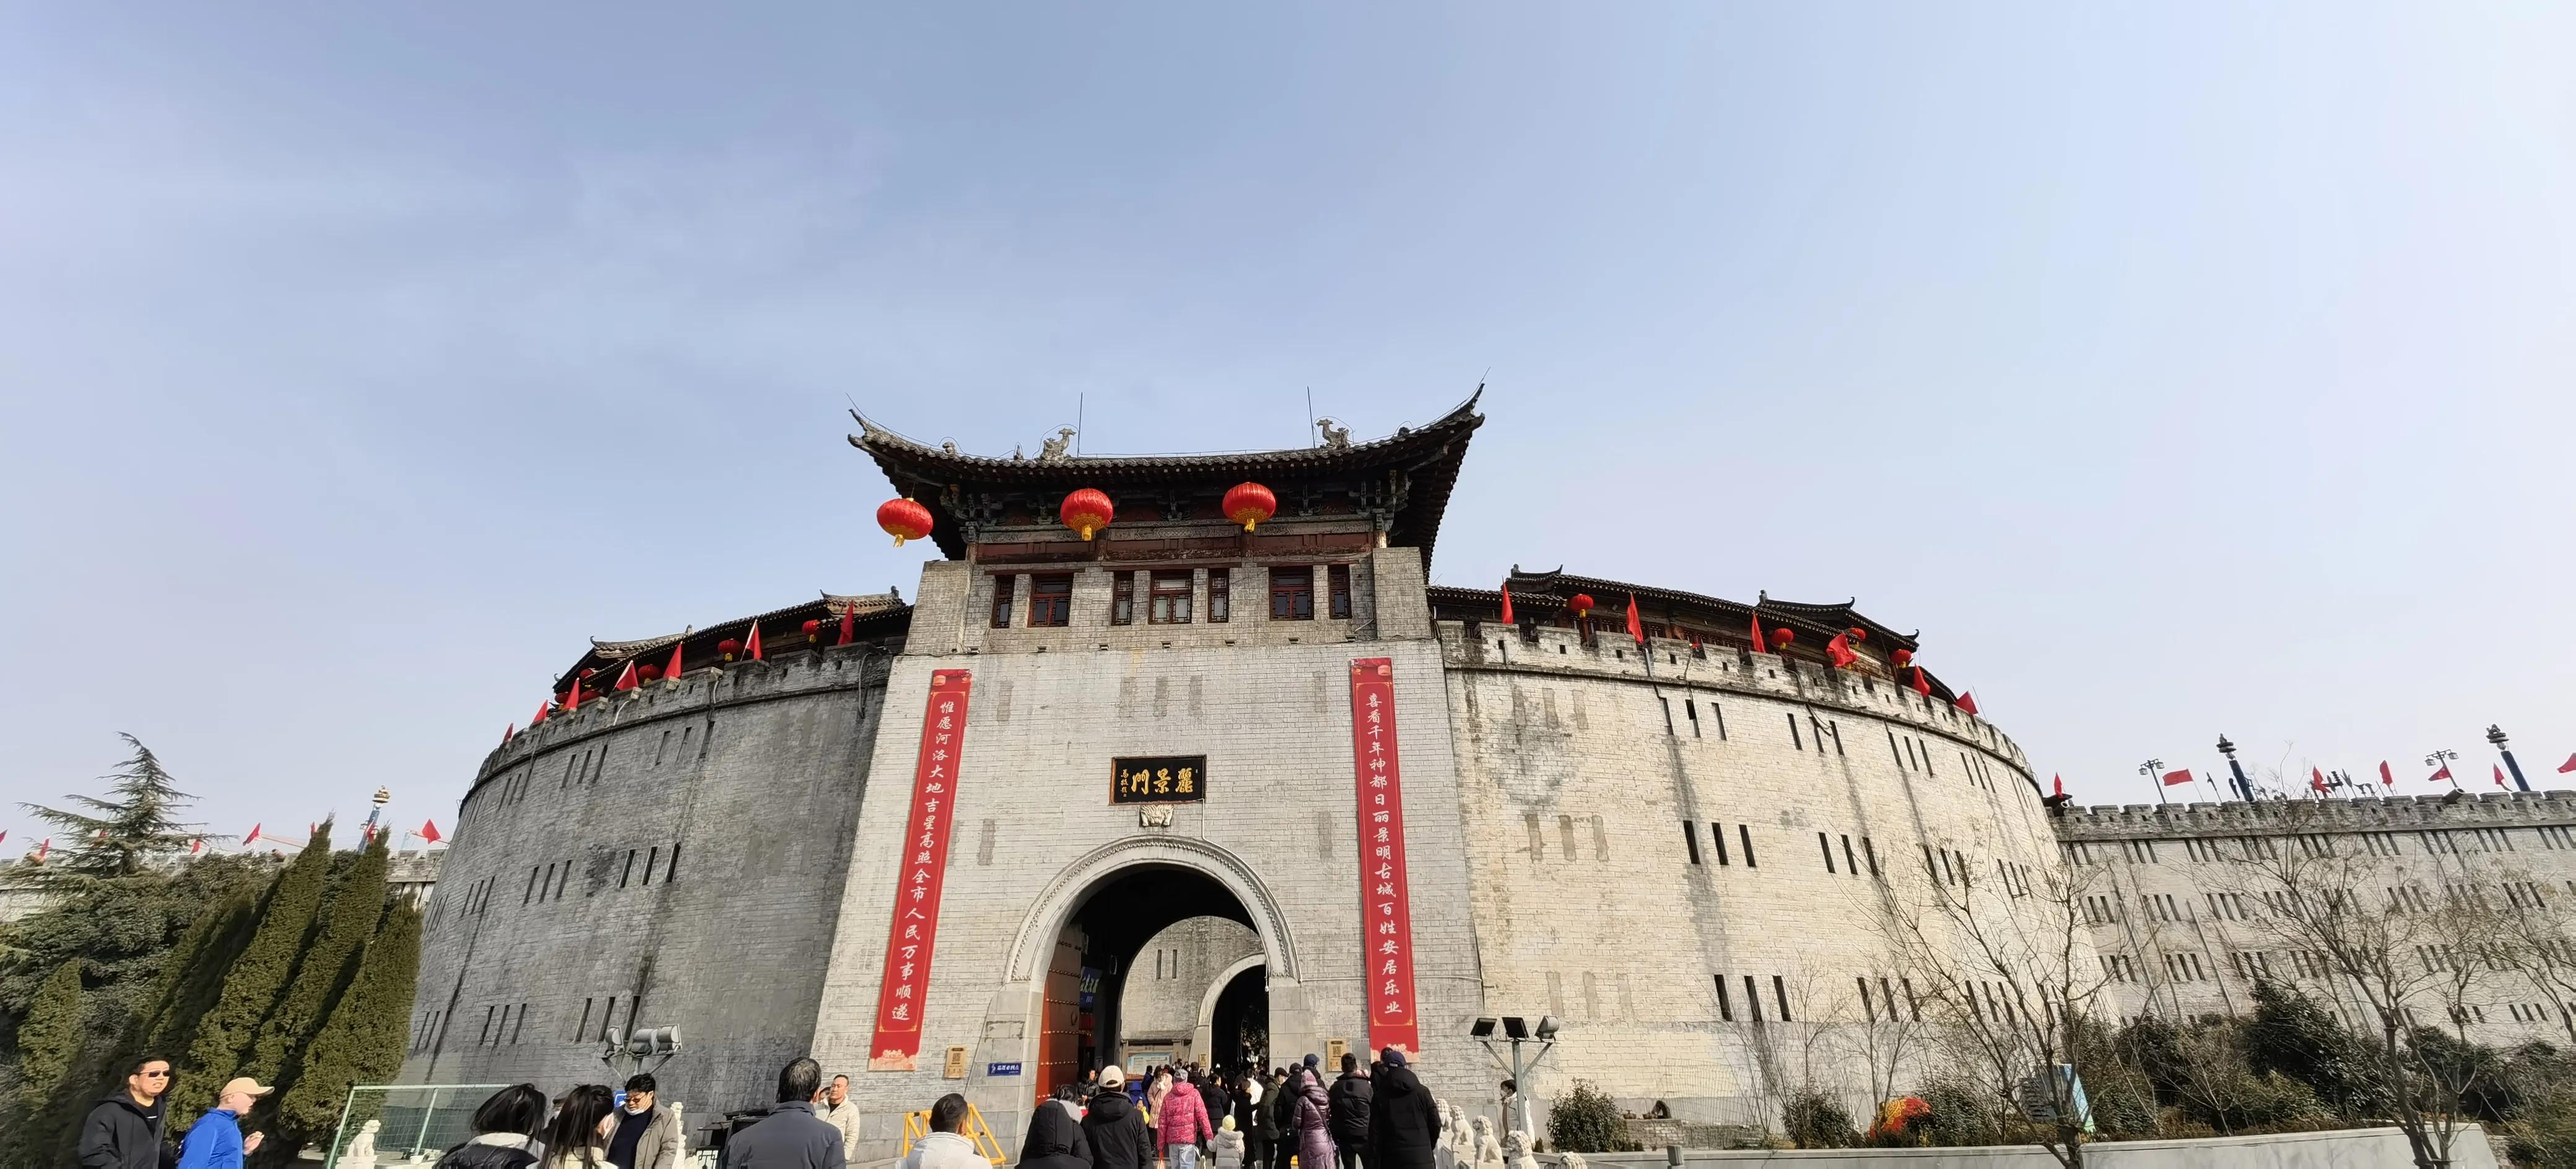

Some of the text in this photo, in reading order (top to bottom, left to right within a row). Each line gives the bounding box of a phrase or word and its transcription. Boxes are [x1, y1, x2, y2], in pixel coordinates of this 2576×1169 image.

[891, 701, 954, 1021] 惟愿河洛大地吉星高照全市人民万事顺遂
[1365, 693, 1403, 1014] 喜看千年神都日丽景明古城百姓安居乐业
